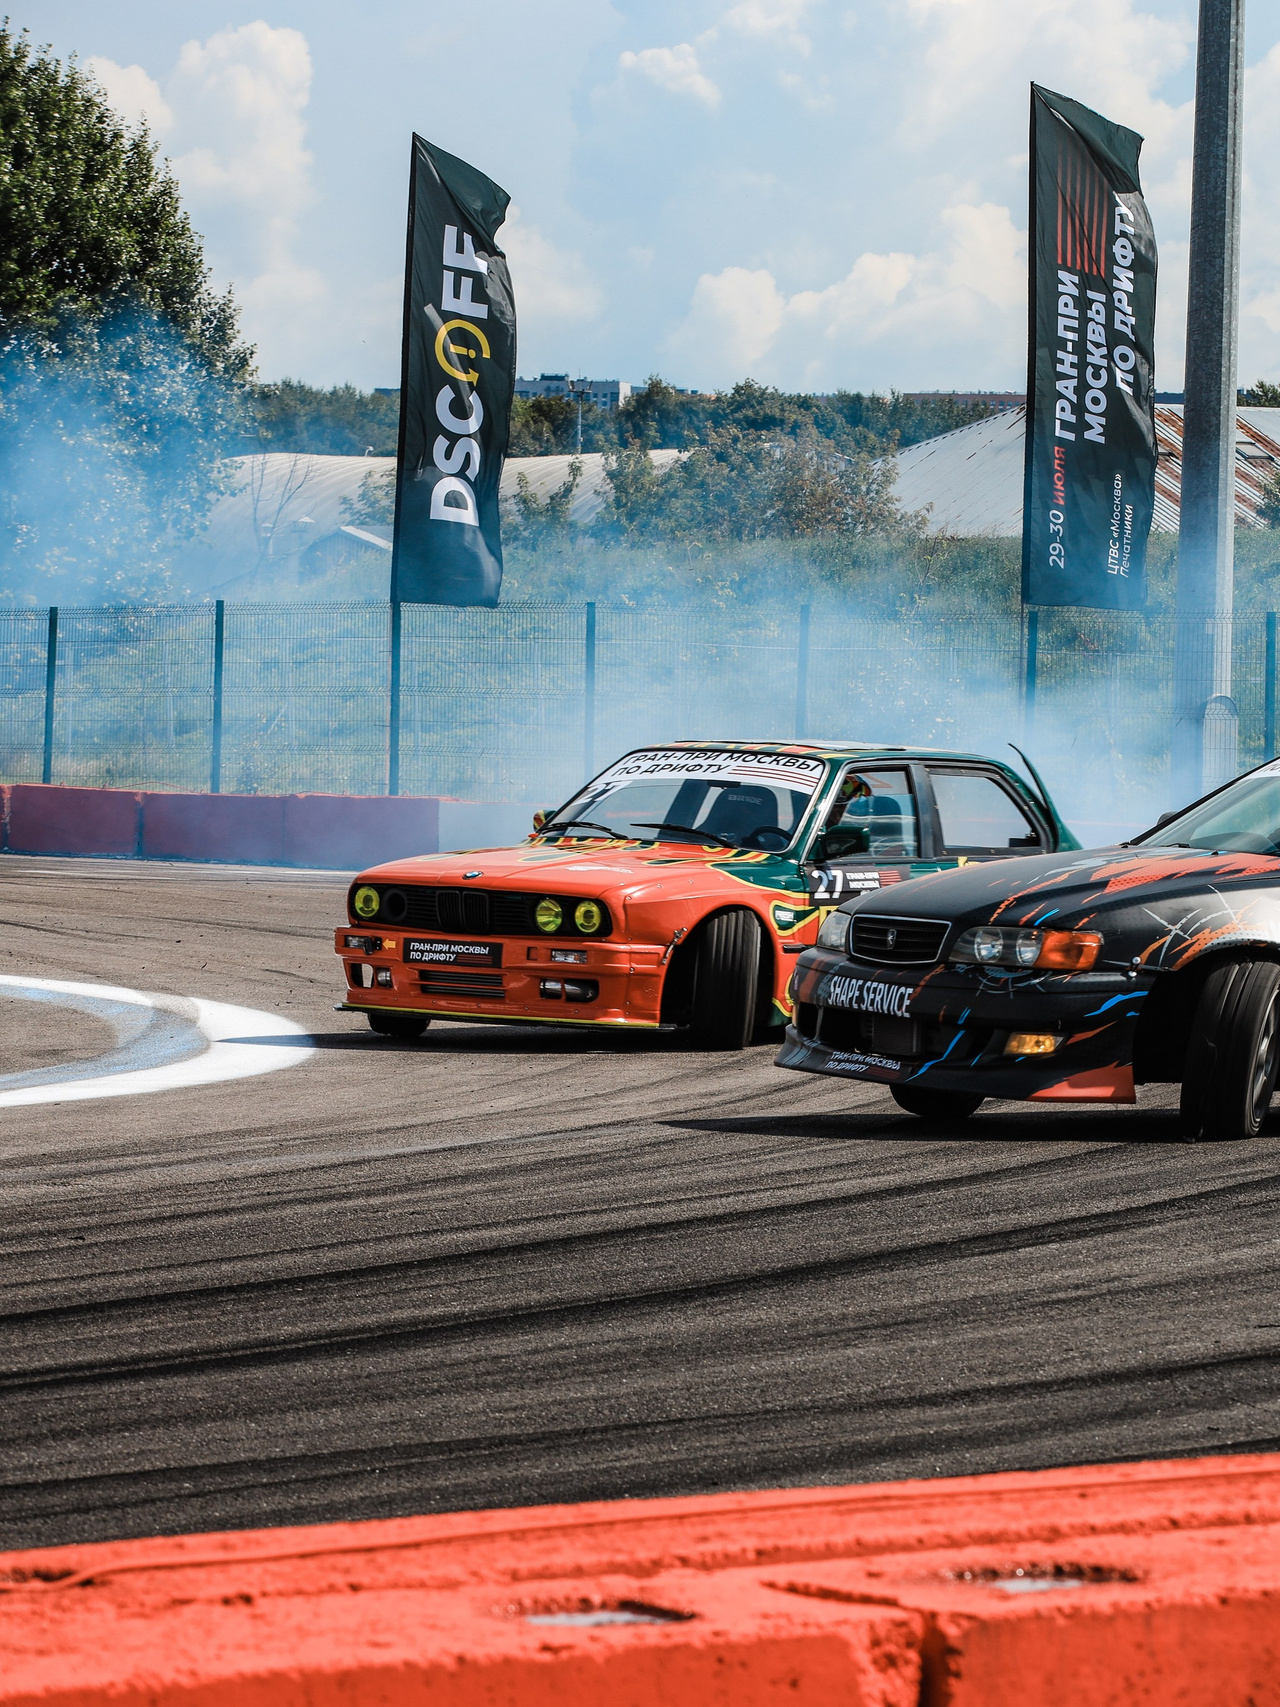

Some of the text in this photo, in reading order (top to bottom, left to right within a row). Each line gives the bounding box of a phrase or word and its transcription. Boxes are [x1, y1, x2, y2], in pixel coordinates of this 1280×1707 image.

[1112, 191, 1136, 396] ПО ДРИФТУ
[1055, 270, 1080, 441] ГРАН-ПРИ
[1084, 290, 1107, 444] МОСКВЫ
[1049, 509, 1065, 570] 29-30
[1107, 539, 1120, 576] ЦТВС
[611, 763, 731, 777] ПО ДРИФТУ
[622, 750, 823, 772] ГРАН-ПРИ МОСКВЫ
[727, 793, 764, 806] BRIDE
[811, 869, 844, 899] 27
[410, 942, 489, 954] ГРАН-ПРИ МОСКВЫ
[410, 952, 456, 961] ПО ДРИФТУ
[828, 975, 864, 1009] SHAPE
[860, 980, 914, 1018] SERVICE
